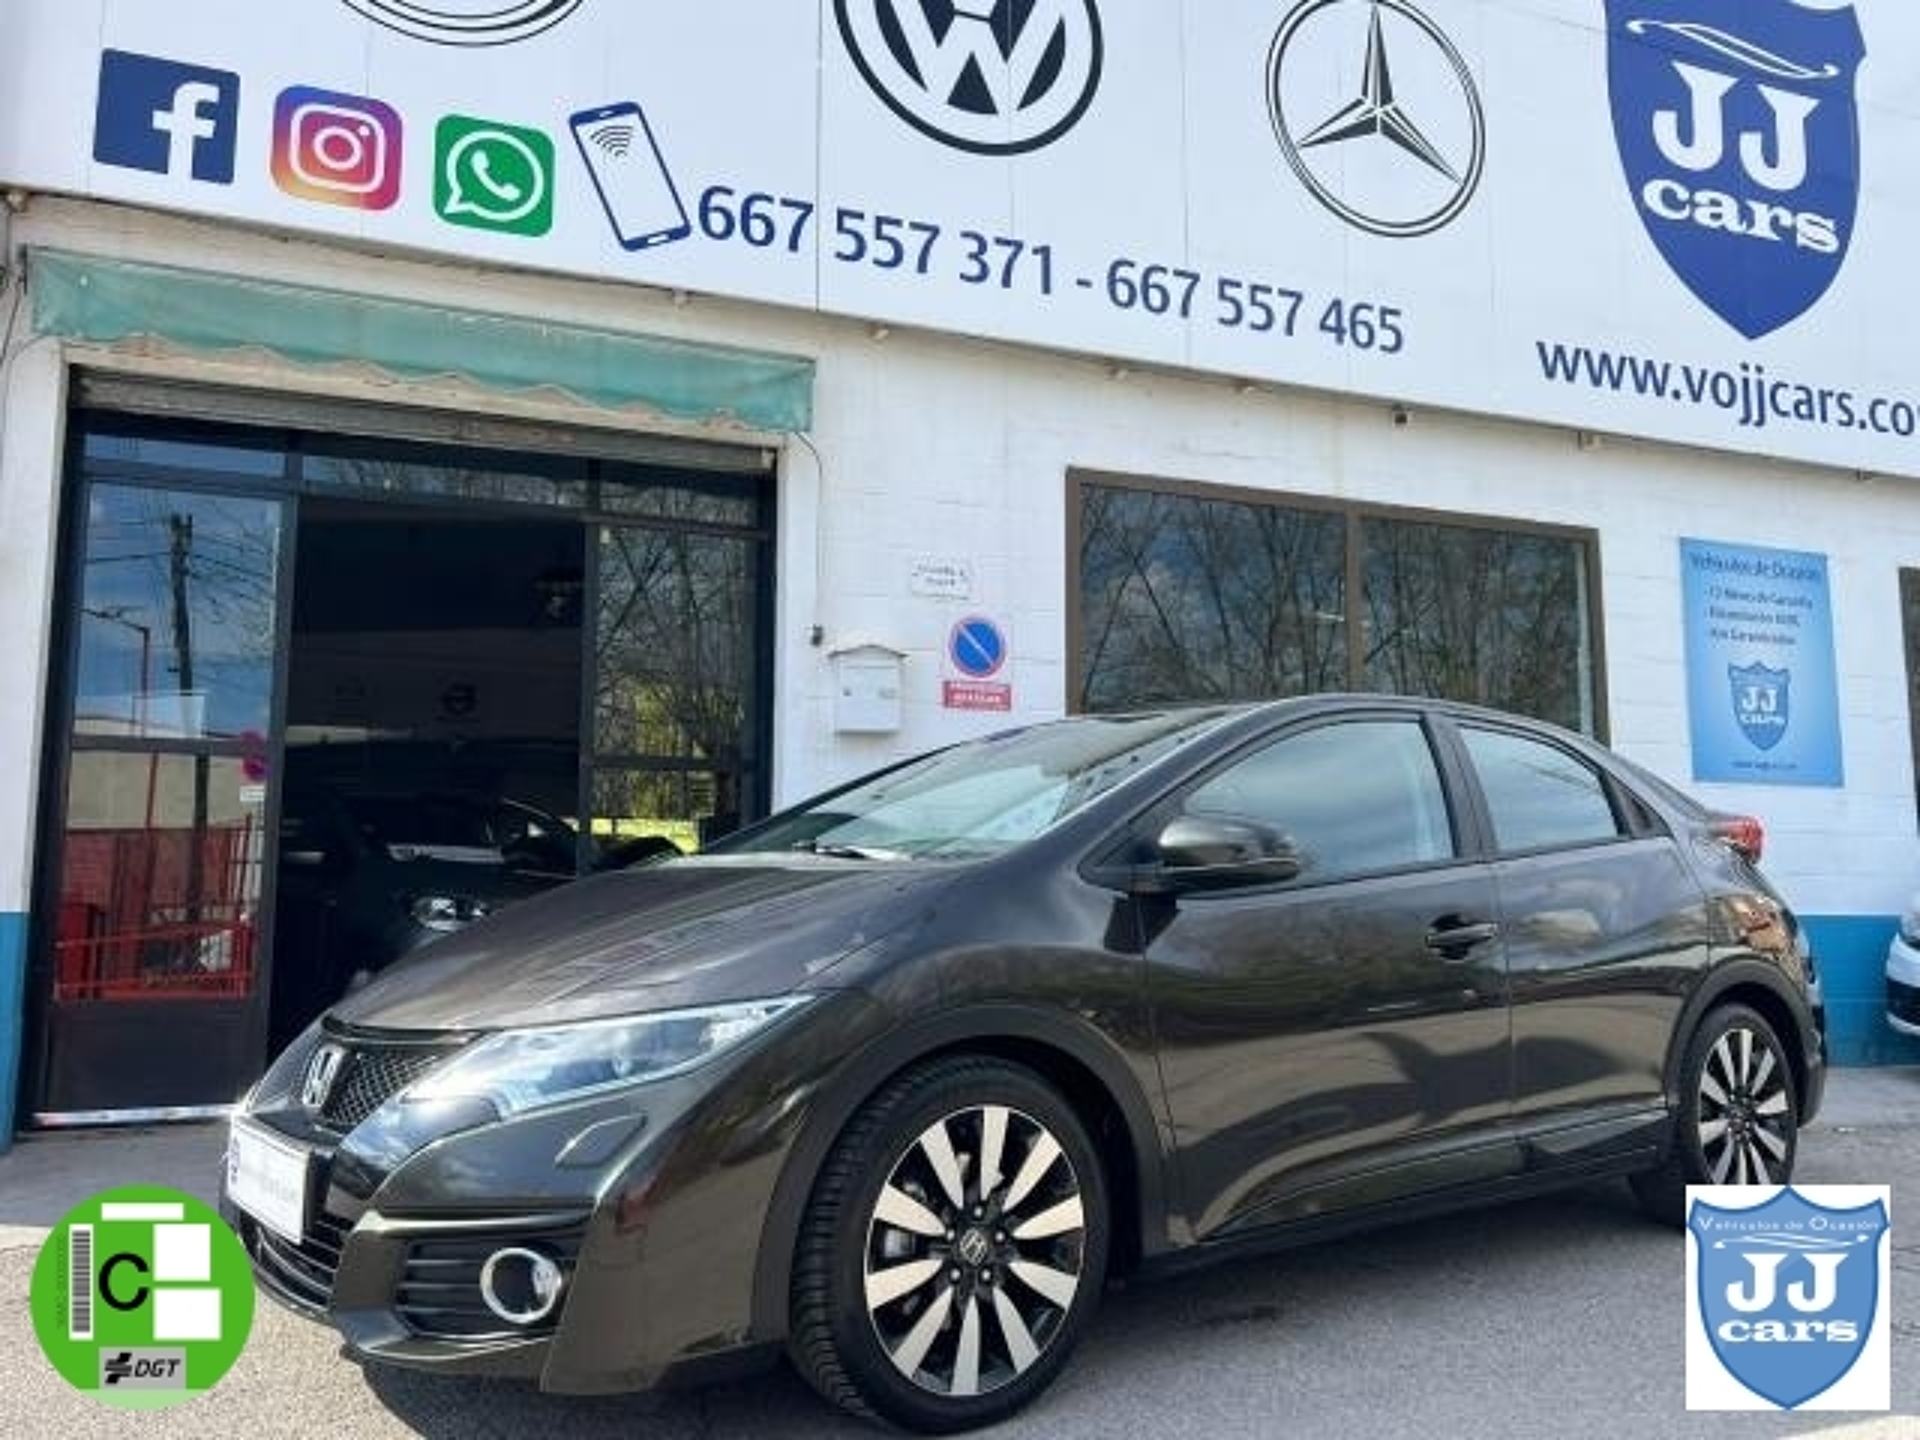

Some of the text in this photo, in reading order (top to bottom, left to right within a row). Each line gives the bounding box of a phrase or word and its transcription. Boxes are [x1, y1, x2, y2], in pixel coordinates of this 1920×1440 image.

[1651, 60, 1821, 191] JJ
[1643, 179, 1839, 253] cars
[700, 185, 814, 253] 667
[834, 208, 940, 275] 557
[959, 230, 1052, 296] 371
[1108, 259, 1200, 319] 667
[1216, 277, 1303, 338] 557
[1319, 299, 1403, 354] 465
[1536, 341, 1920, 436] www.vojjcars.co
[1740, 686, 1777, 713] JJ
